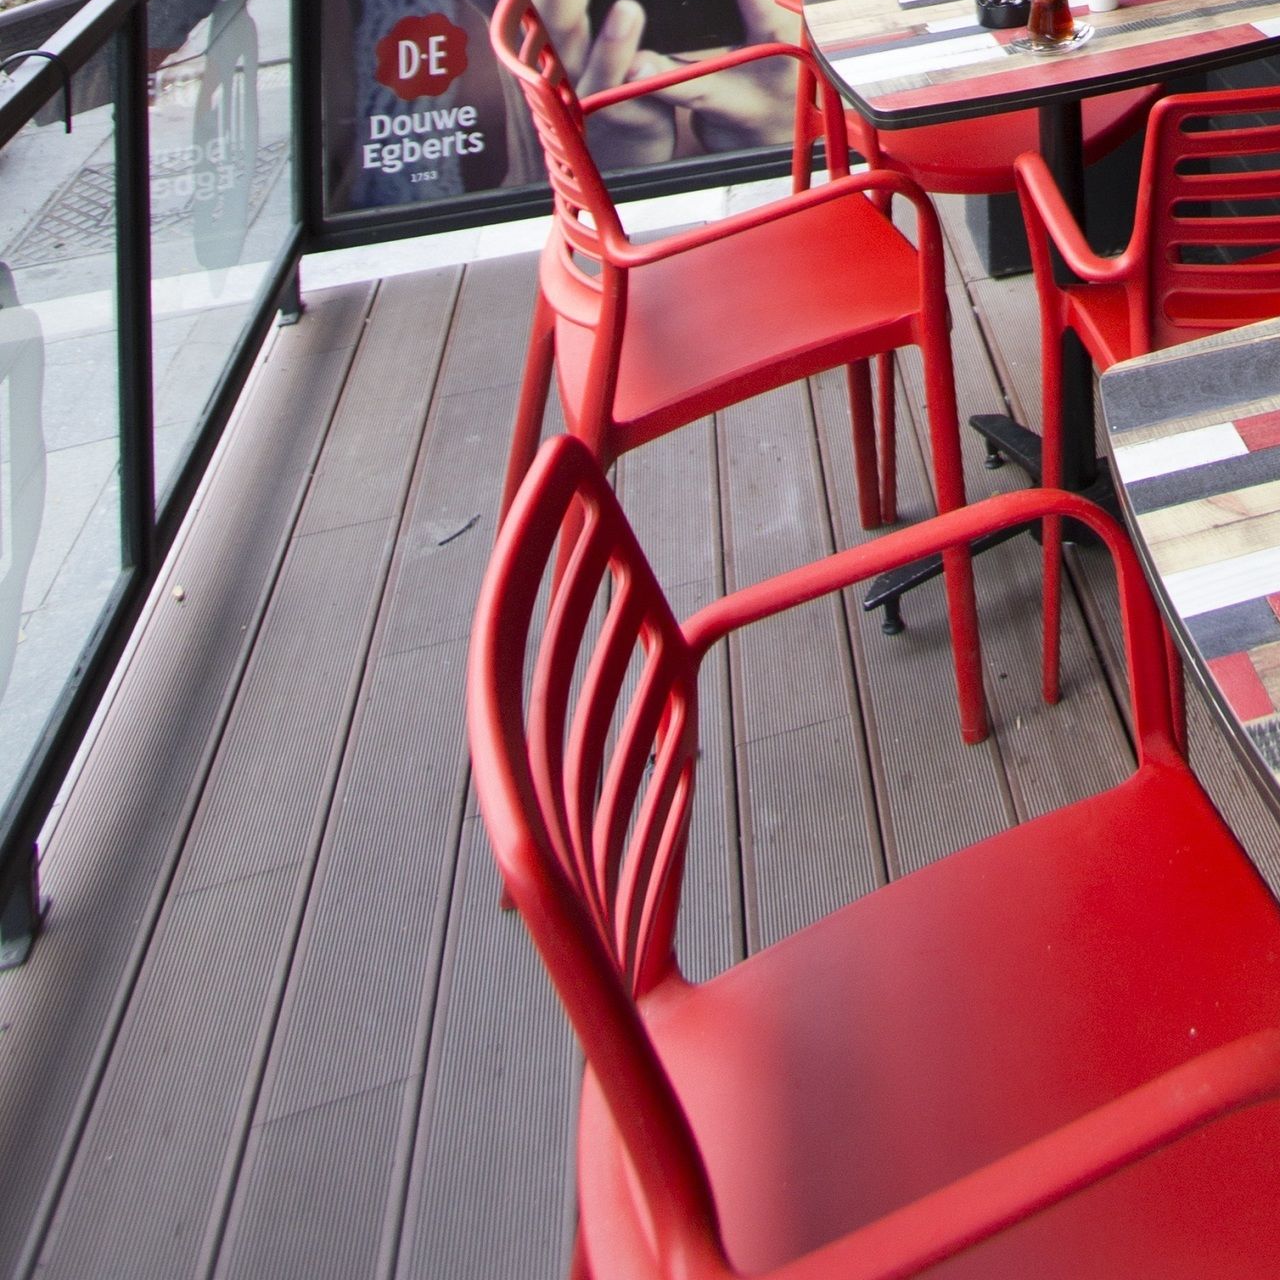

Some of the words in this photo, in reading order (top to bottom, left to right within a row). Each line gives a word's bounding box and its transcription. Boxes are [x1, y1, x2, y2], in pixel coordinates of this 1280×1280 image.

[369, 104, 478, 140] Douwe
[362, 129, 486, 174] Egberts
[410, 170, 438, 183] 1753
